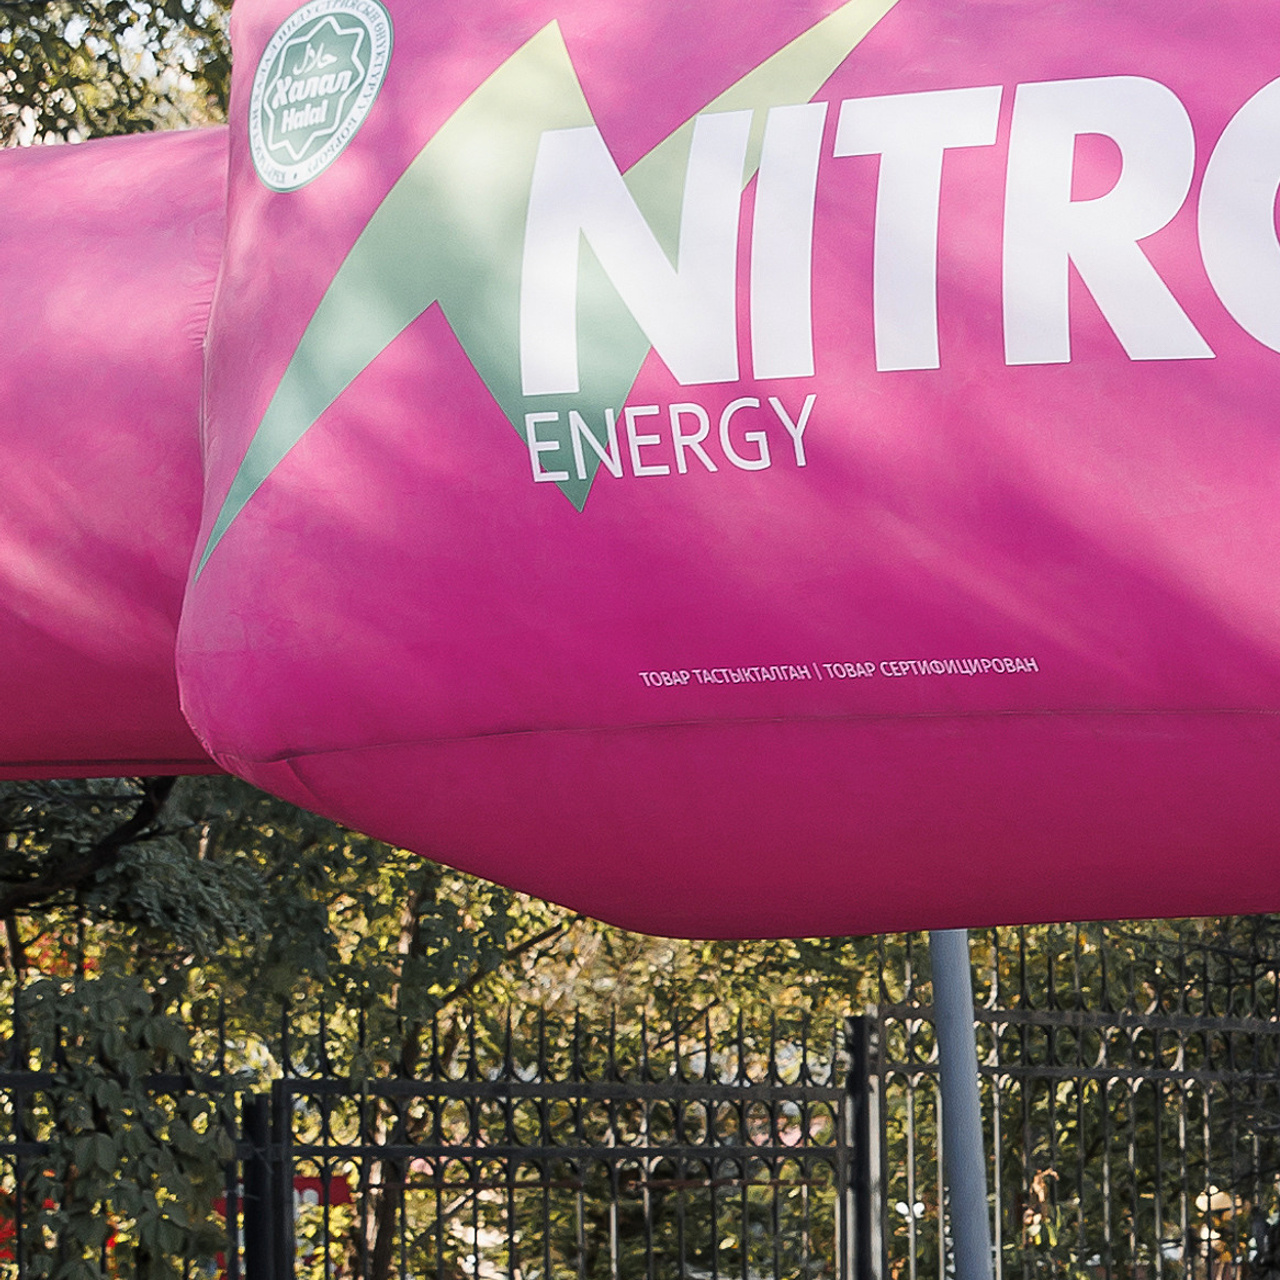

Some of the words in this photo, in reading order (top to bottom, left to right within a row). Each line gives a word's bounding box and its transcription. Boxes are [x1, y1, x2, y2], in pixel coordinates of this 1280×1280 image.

[271, 70, 353, 110] Халал
[280, 99, 329, 134] Halal
[523, 394, 817, 484] ENERGY
[639, 671, 691, 687] ТОВАР
[691, 664, 812, 684] ТАСТЫКТАЛГАН
[822, 662, 876, 679] ТОВАР
[879, 657, 1040, 677] СЕРТИФИЦИРОВАН
